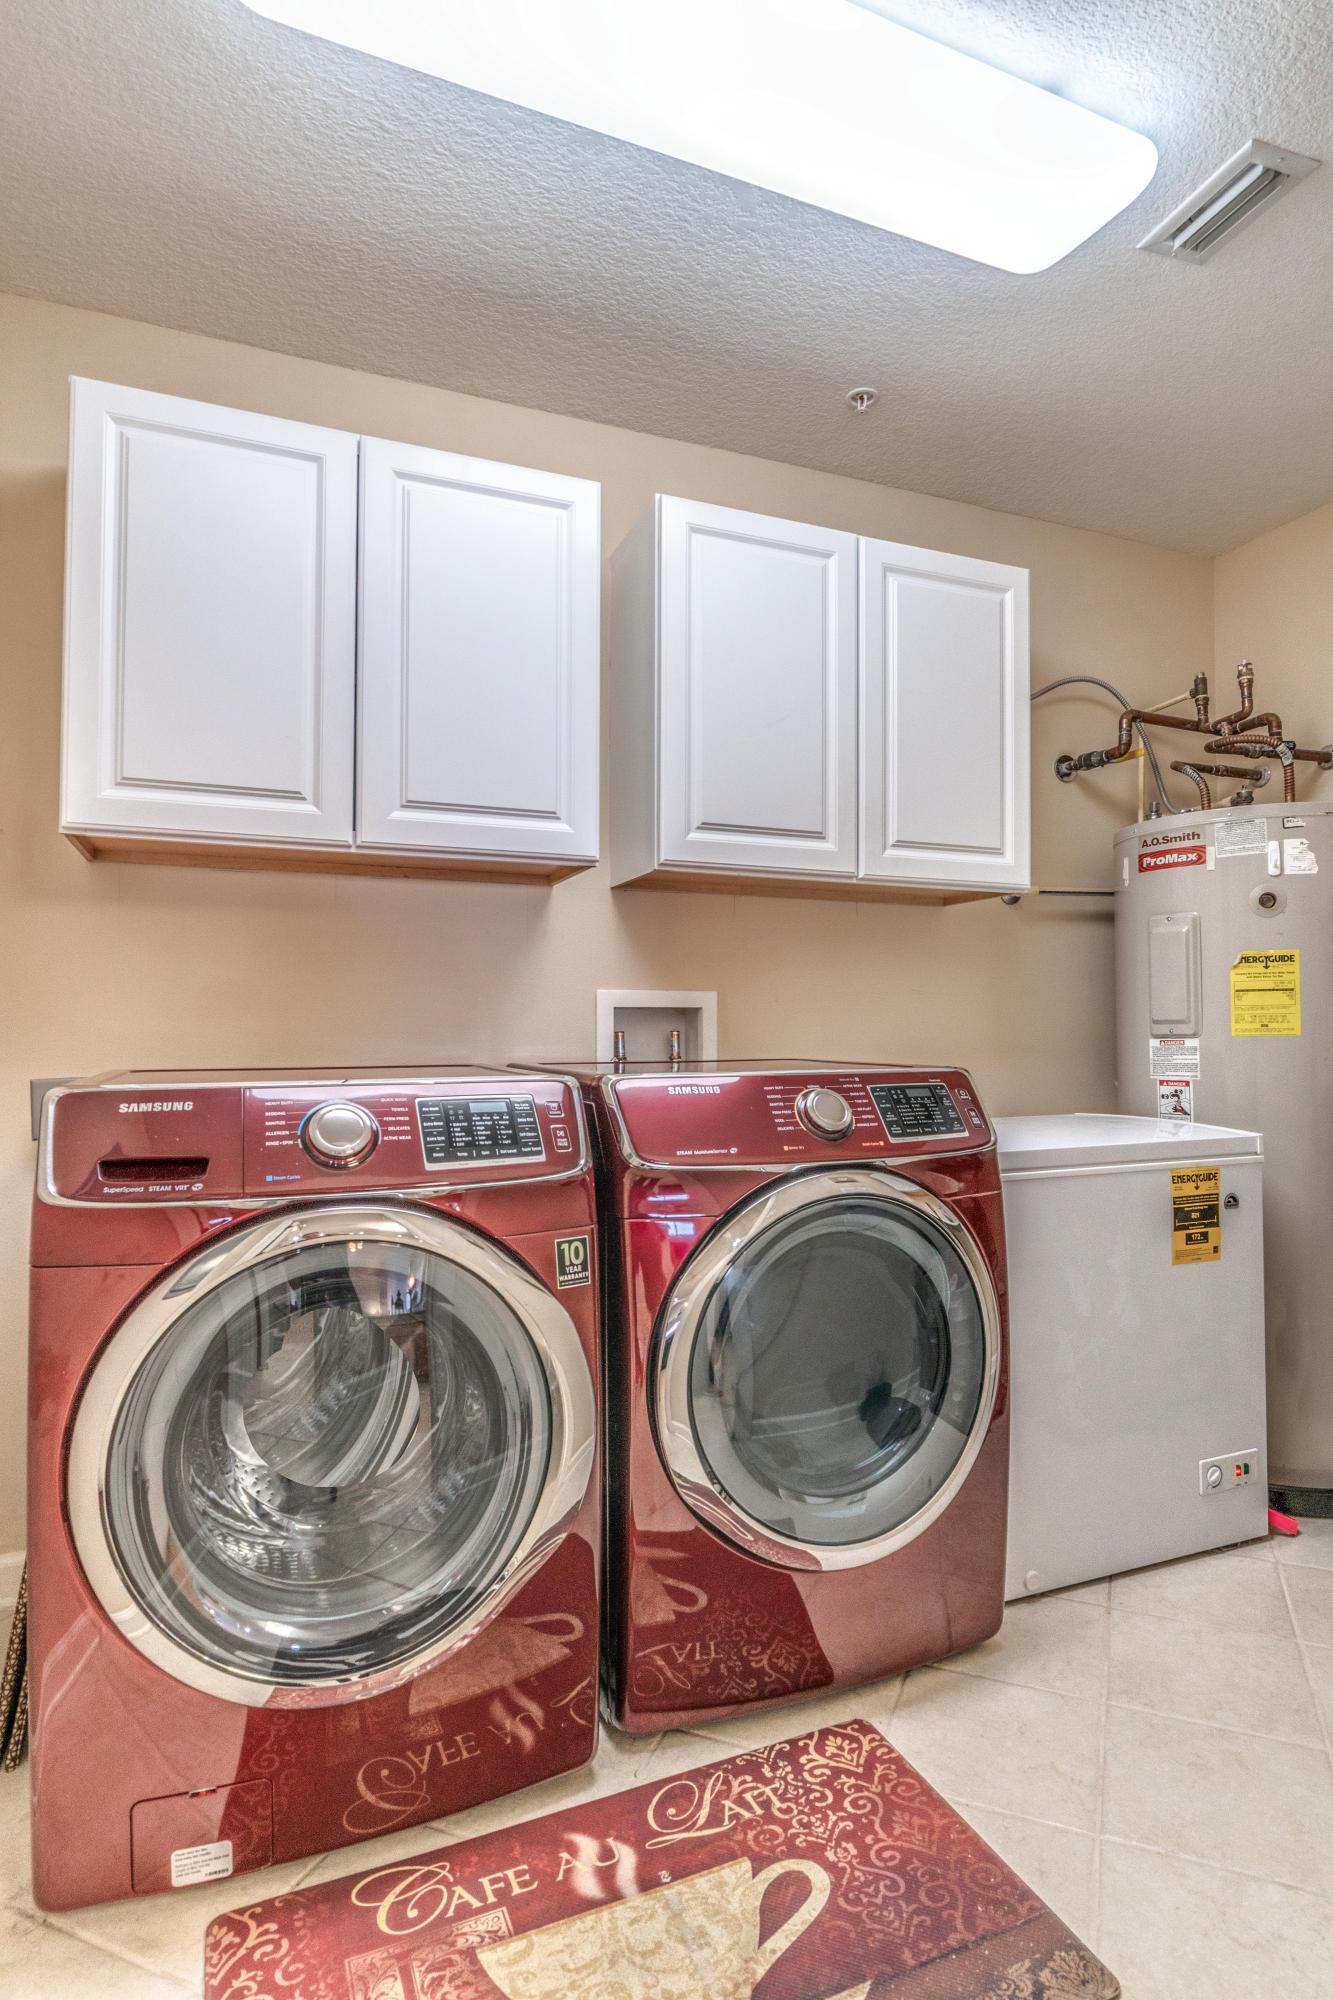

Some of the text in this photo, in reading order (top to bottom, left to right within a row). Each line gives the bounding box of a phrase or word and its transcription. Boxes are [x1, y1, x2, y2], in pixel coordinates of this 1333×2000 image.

[1142, 832, 1200, 848] A.O.Smith
[1143, 852, 1198, 868] ProMax
[1240, 954, 1295, 964] NERGYGUIDE
[668, 1086, 720, 1094] SAMSUNG
[119, 1101, 194, 1112] SAMSUNG
[560, 1241, 584, 1266] 10
[565, 1265, 582, 1274] YEAR
[560, 1272, 589, 1281] WARRANTY
[352, 1862, 538, 1935] CAFE
